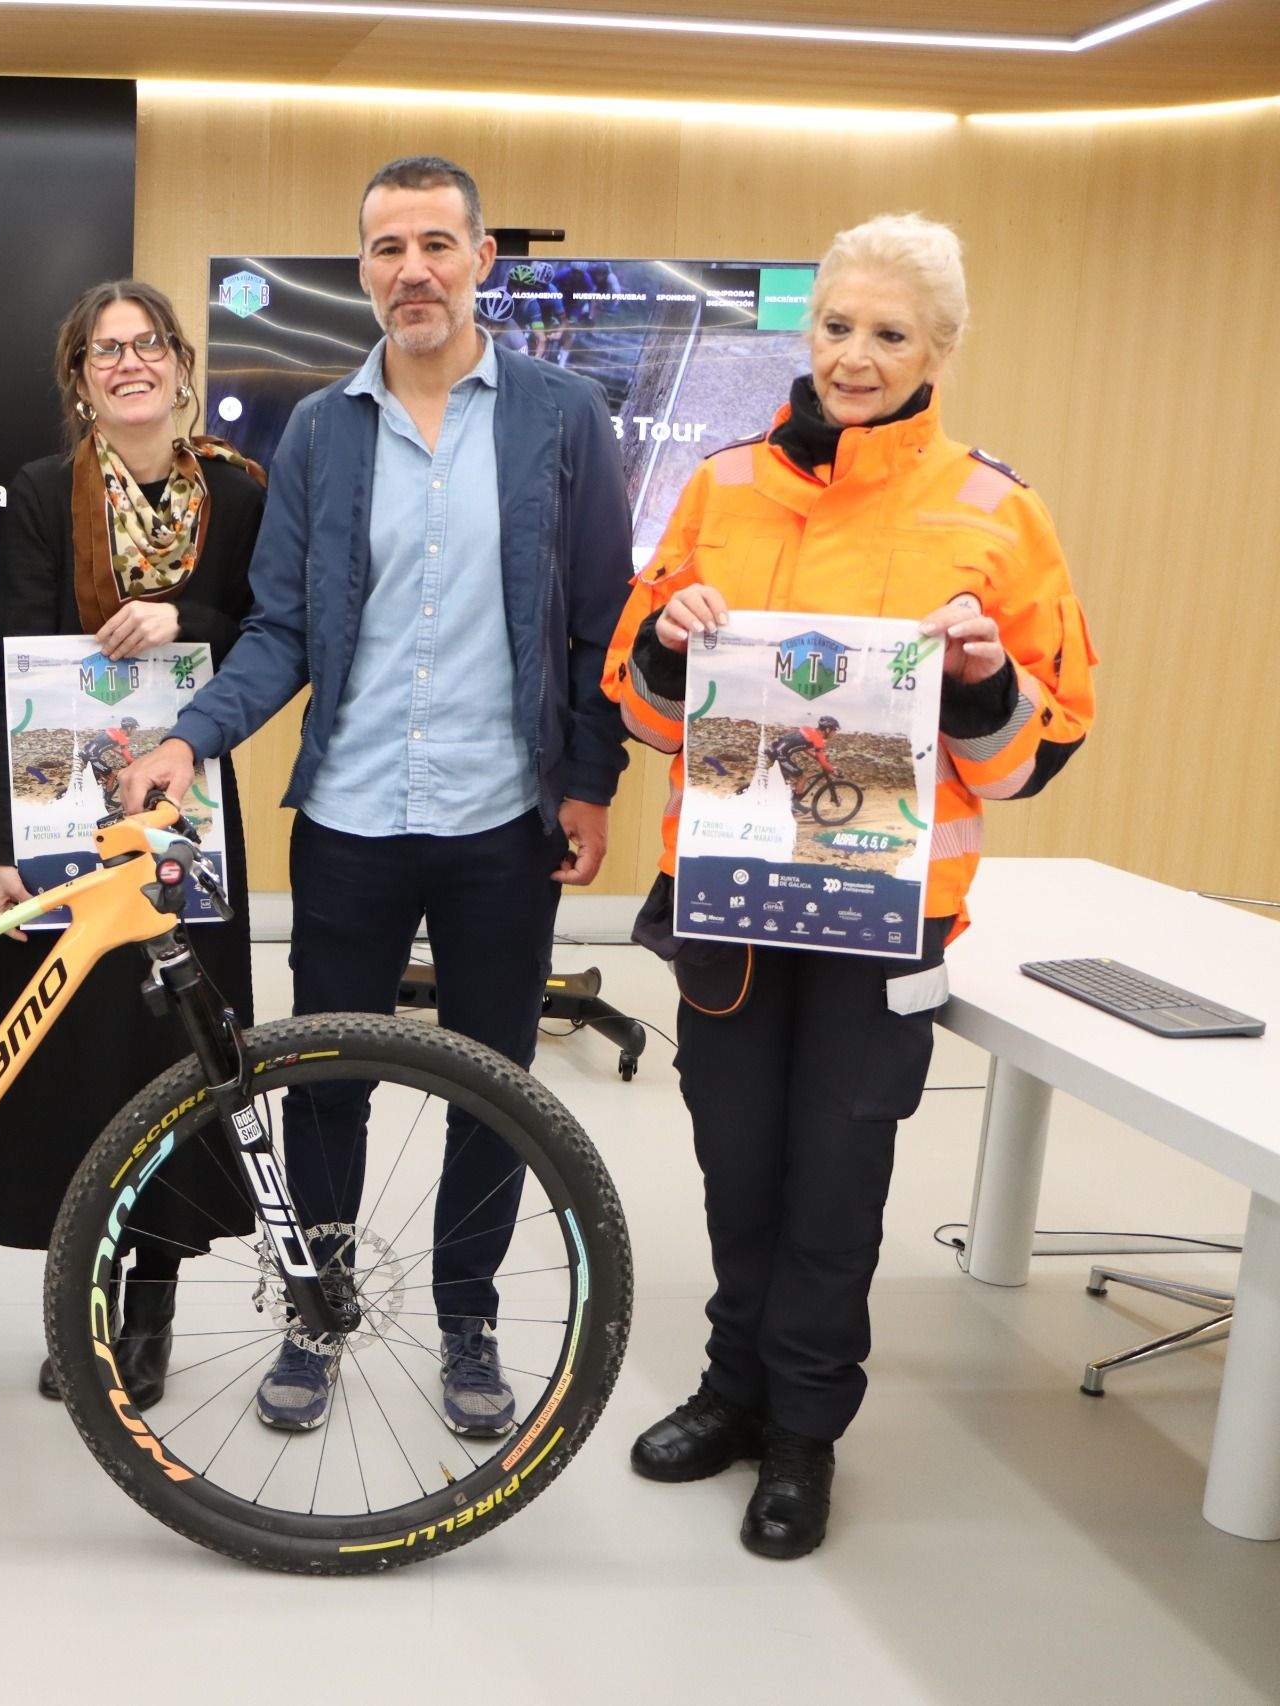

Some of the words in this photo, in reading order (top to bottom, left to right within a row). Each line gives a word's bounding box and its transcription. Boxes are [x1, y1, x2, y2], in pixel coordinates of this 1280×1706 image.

[612, 293, 647, 301] PRUEBAS
[633, 416, 706, 441] Tour
[894, 641, 918, 665] 20
[176, 671, 194, 689] 25
[892, 667, 916, 691] 25
[66, 823, 75, 838] 2
[740, 823, 752, 840] 2
[832, 833, 859, 846] ABRIL
[879, 837, 888, 849] 6
[405, 1473, 521, 1547] PIRELLI
